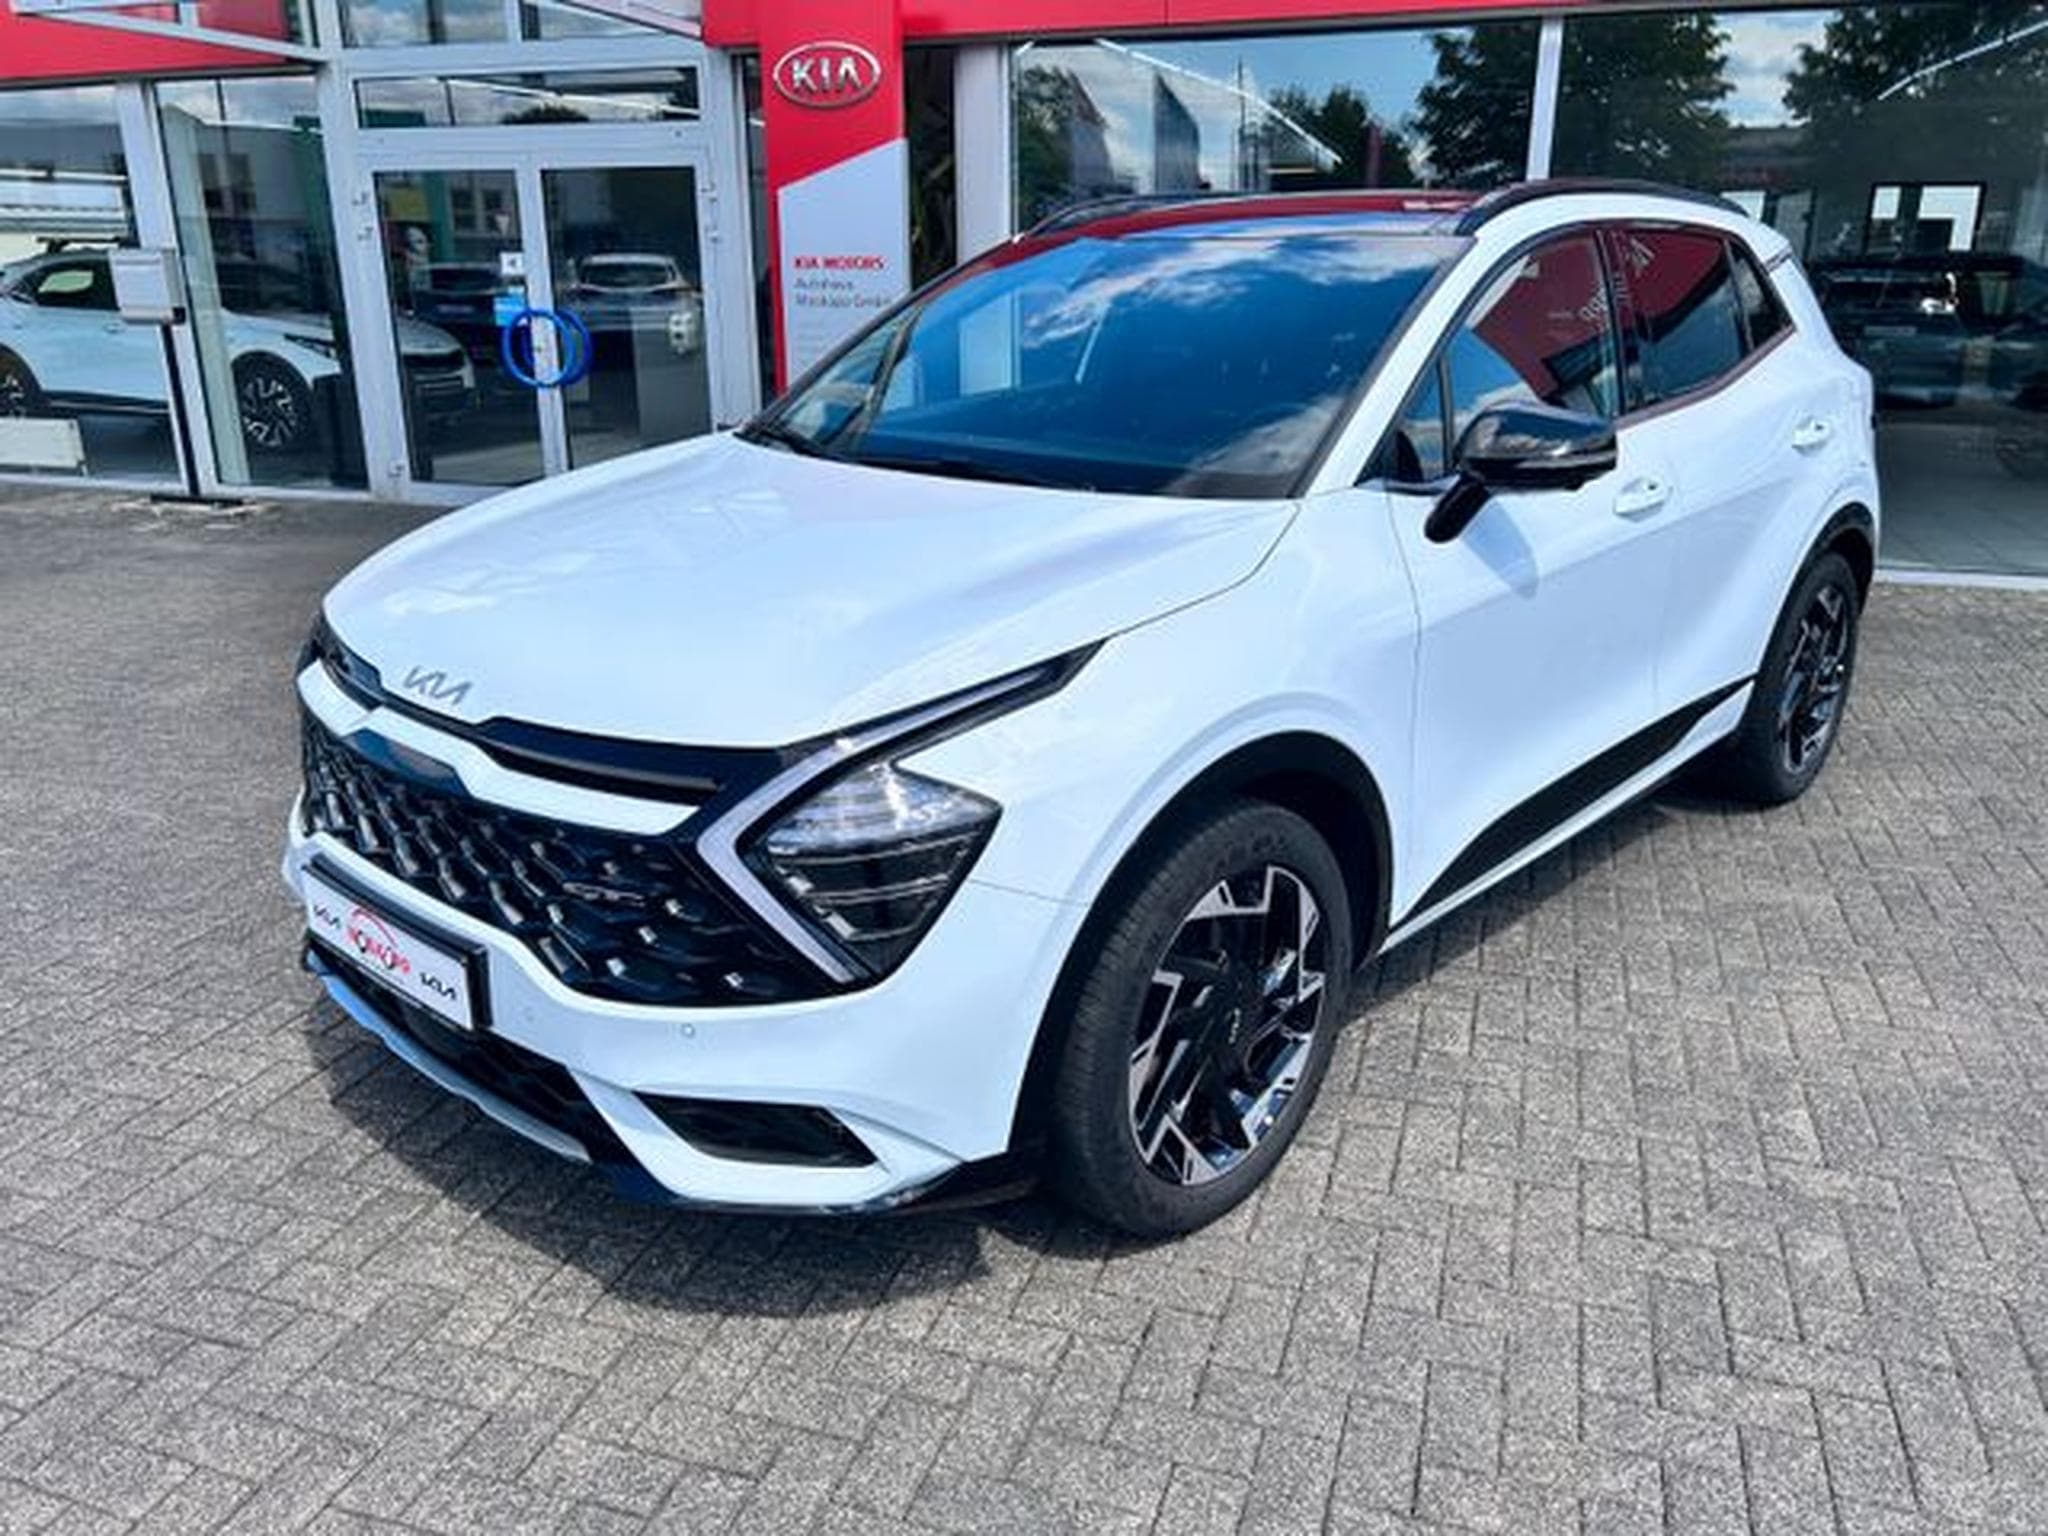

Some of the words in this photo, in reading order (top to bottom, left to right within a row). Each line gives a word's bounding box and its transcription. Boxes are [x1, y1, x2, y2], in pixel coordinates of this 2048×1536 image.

[792, 57, 861, 91] KIA
[795, 256, 819, 268] KIA
[823, 256, 885, 269] MOTORS
[404, 665, 472, 705] KIA
[420, 972, 457, 1001] KIA
